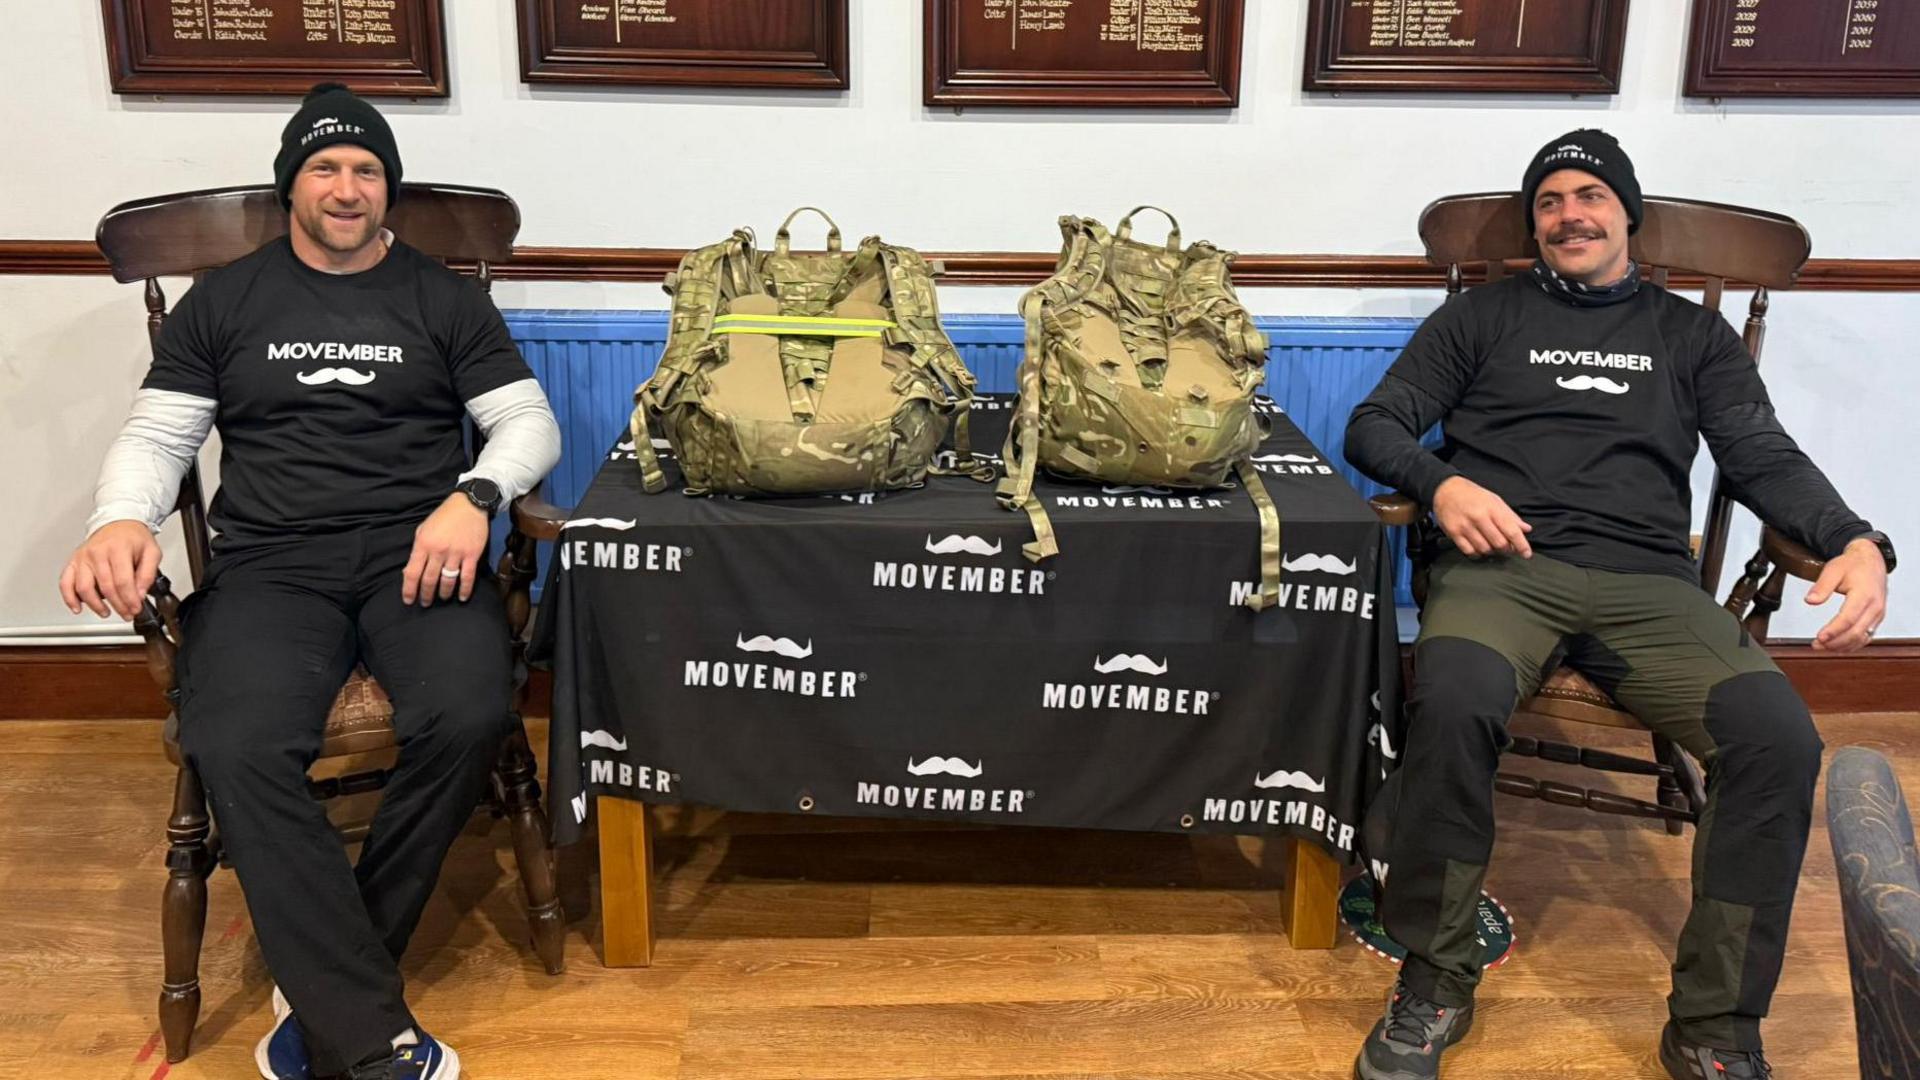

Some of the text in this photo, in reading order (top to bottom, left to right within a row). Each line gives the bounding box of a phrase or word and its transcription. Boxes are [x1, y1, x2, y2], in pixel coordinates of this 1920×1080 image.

[984, 9, 1006, 19] Colts
[267, 342, 404, 363] MOVEMBER
[1529, 349, 1653, 371] MOVEMBER
[872, 561, 1046, 595] MOVEMBER
[1229, 581, 1376, 620] MVEMBE
[684, 660, 857, 698] MOVEMBER
[1043, 682, 1210, 715] MOVEMBER
[856, 781, 1024, 812] MOVEMBER
[1203, 798, 1355, 851] MOVEMBER
